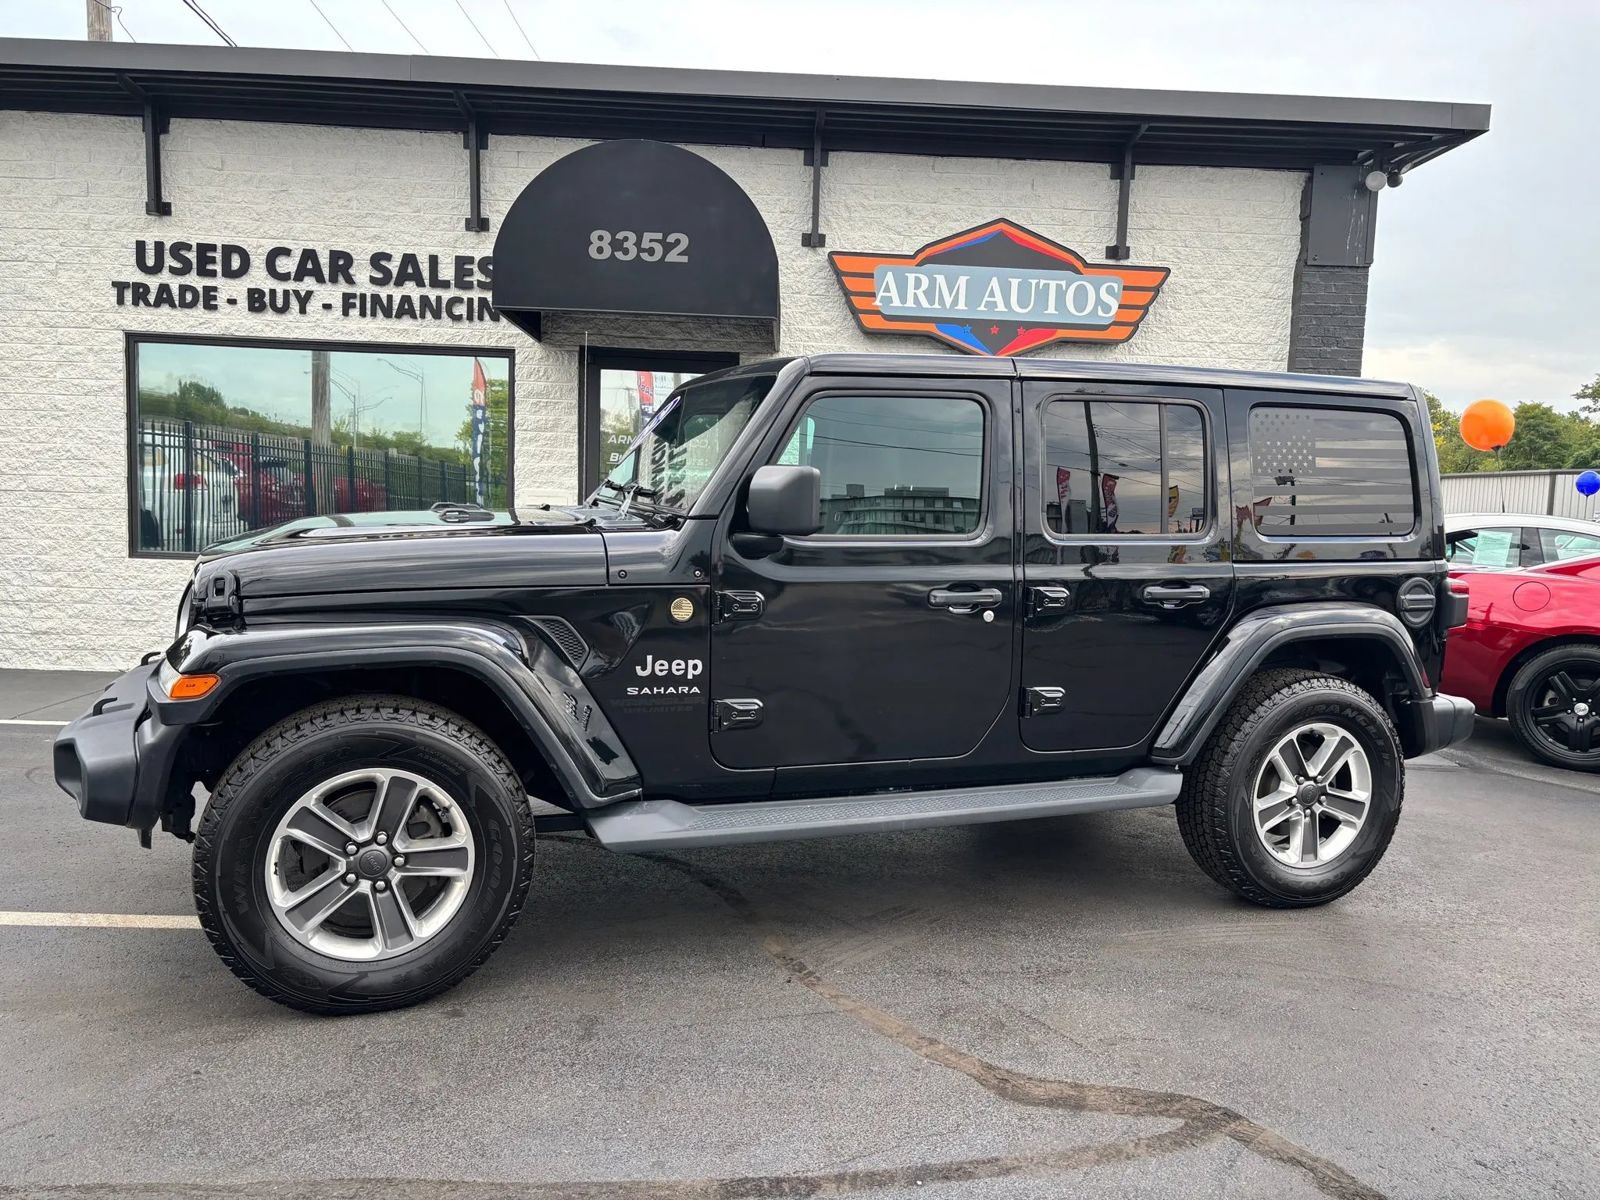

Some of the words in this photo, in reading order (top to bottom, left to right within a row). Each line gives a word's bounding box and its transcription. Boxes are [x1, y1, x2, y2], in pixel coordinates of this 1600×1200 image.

[588, 229, 689, 263] 8352
[134, 239, 251, 279] USED
[264, 246, 356, 285] CAR
[368, 251, 493, 291] SALES
[111, 281, 218, 310] TRADE
[247, 288, 314, 315] BUY
[872, 271, 970, 311] ARM
[976, 276, 1120, 318] AUTOS
[635, 654, 703, 680] Jeep
[626, 685, 701, 696] SAHARA
